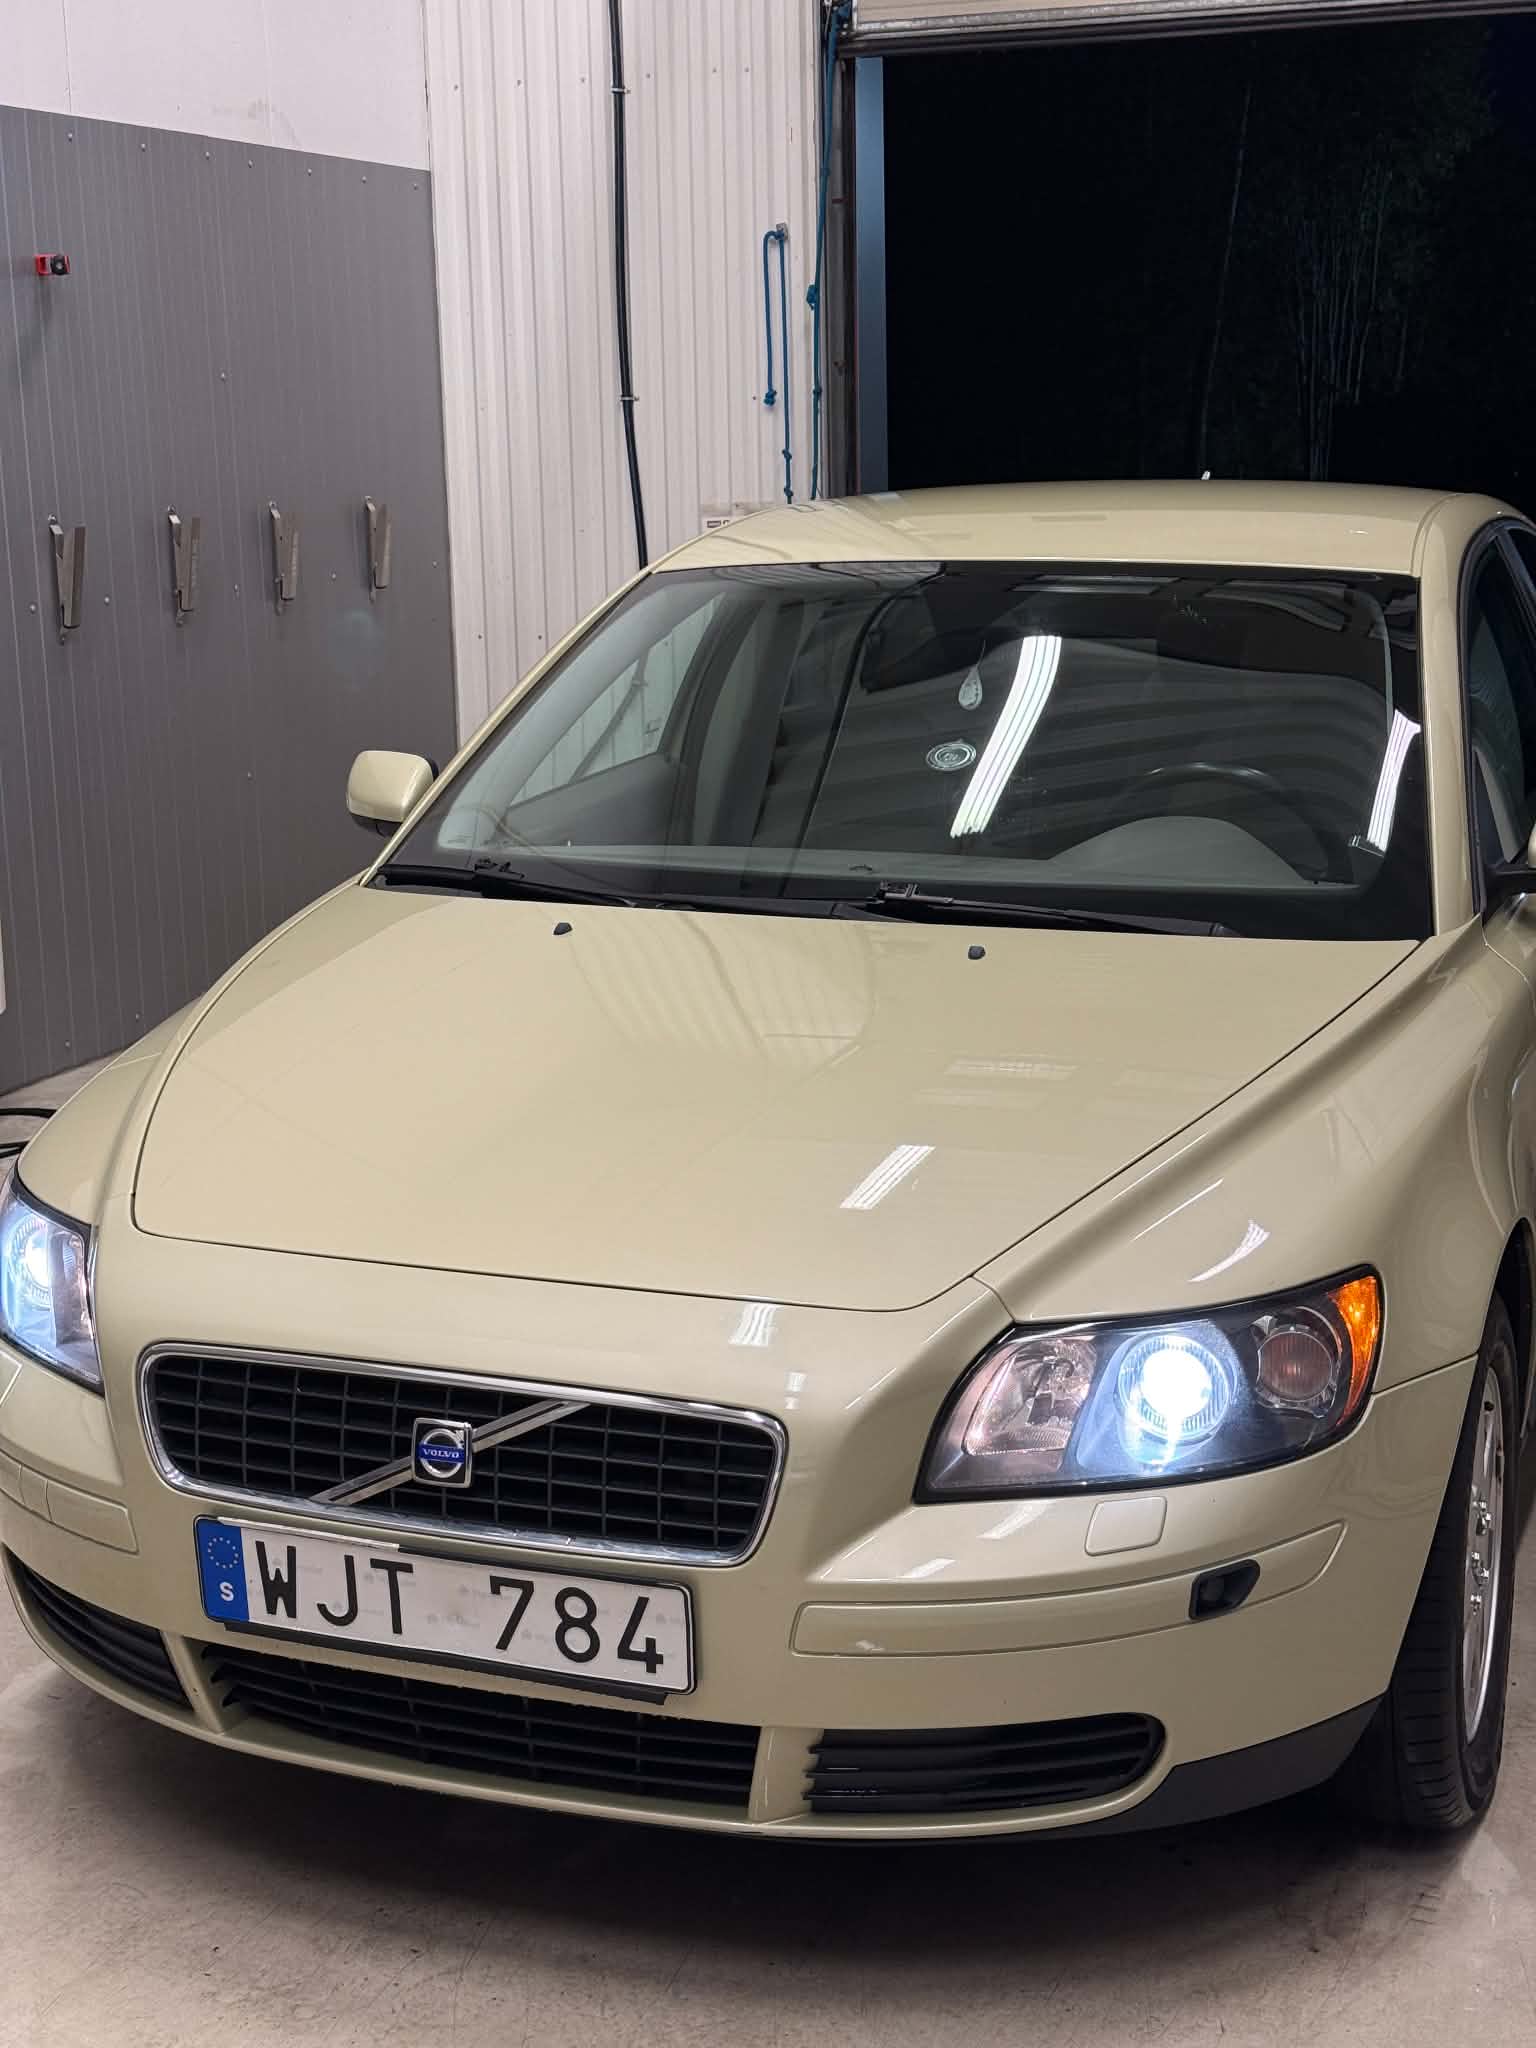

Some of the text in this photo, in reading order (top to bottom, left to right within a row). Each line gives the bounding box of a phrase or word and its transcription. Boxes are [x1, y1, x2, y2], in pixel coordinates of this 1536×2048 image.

[422, 1447, 460, 1459] VOLVO
[220, 1582, 234, 1601] S
[255, 1541, 664, 1674] WJT 784
